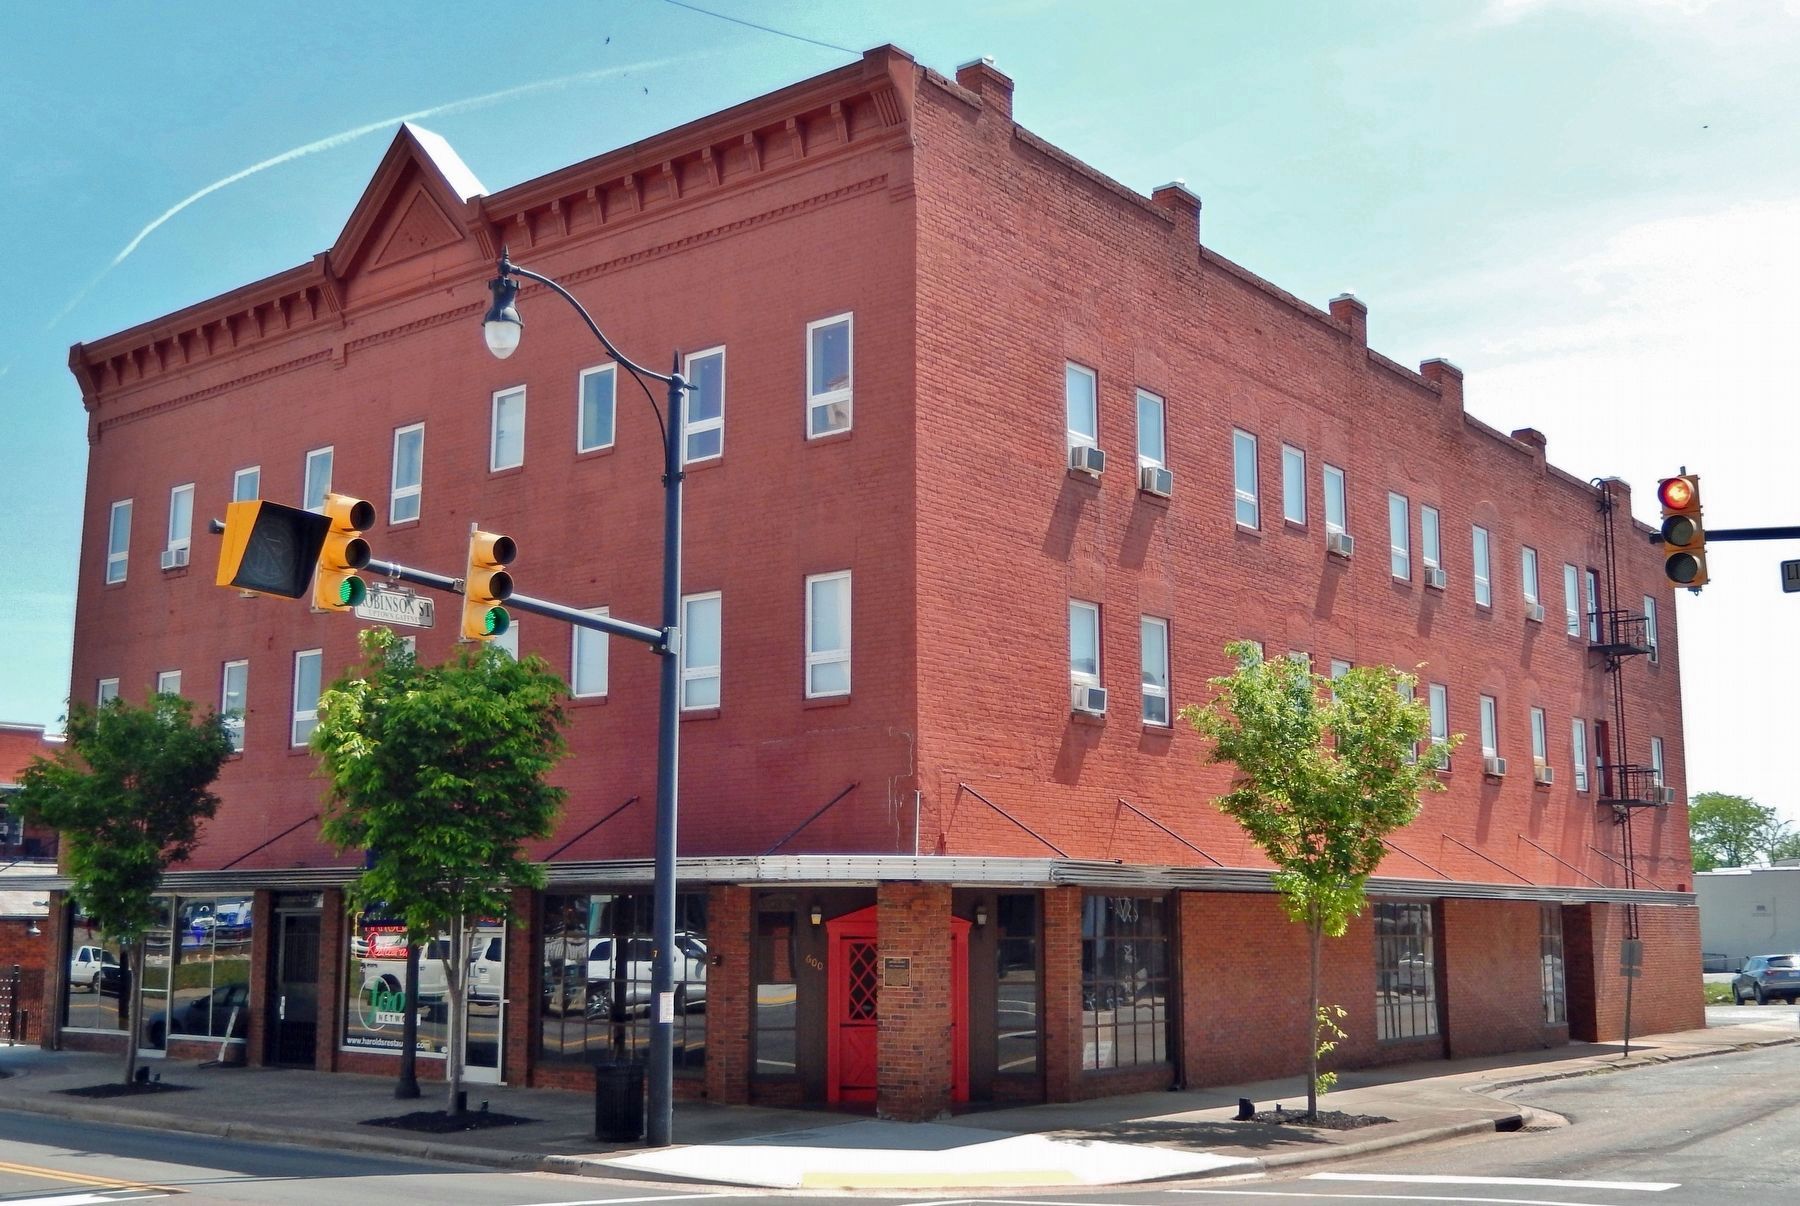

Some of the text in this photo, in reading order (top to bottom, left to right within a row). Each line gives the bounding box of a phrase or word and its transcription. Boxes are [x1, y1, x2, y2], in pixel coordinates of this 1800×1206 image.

[362, 593, 432, 617] OBINSON ST
[805, 954, 823, 971] 600
